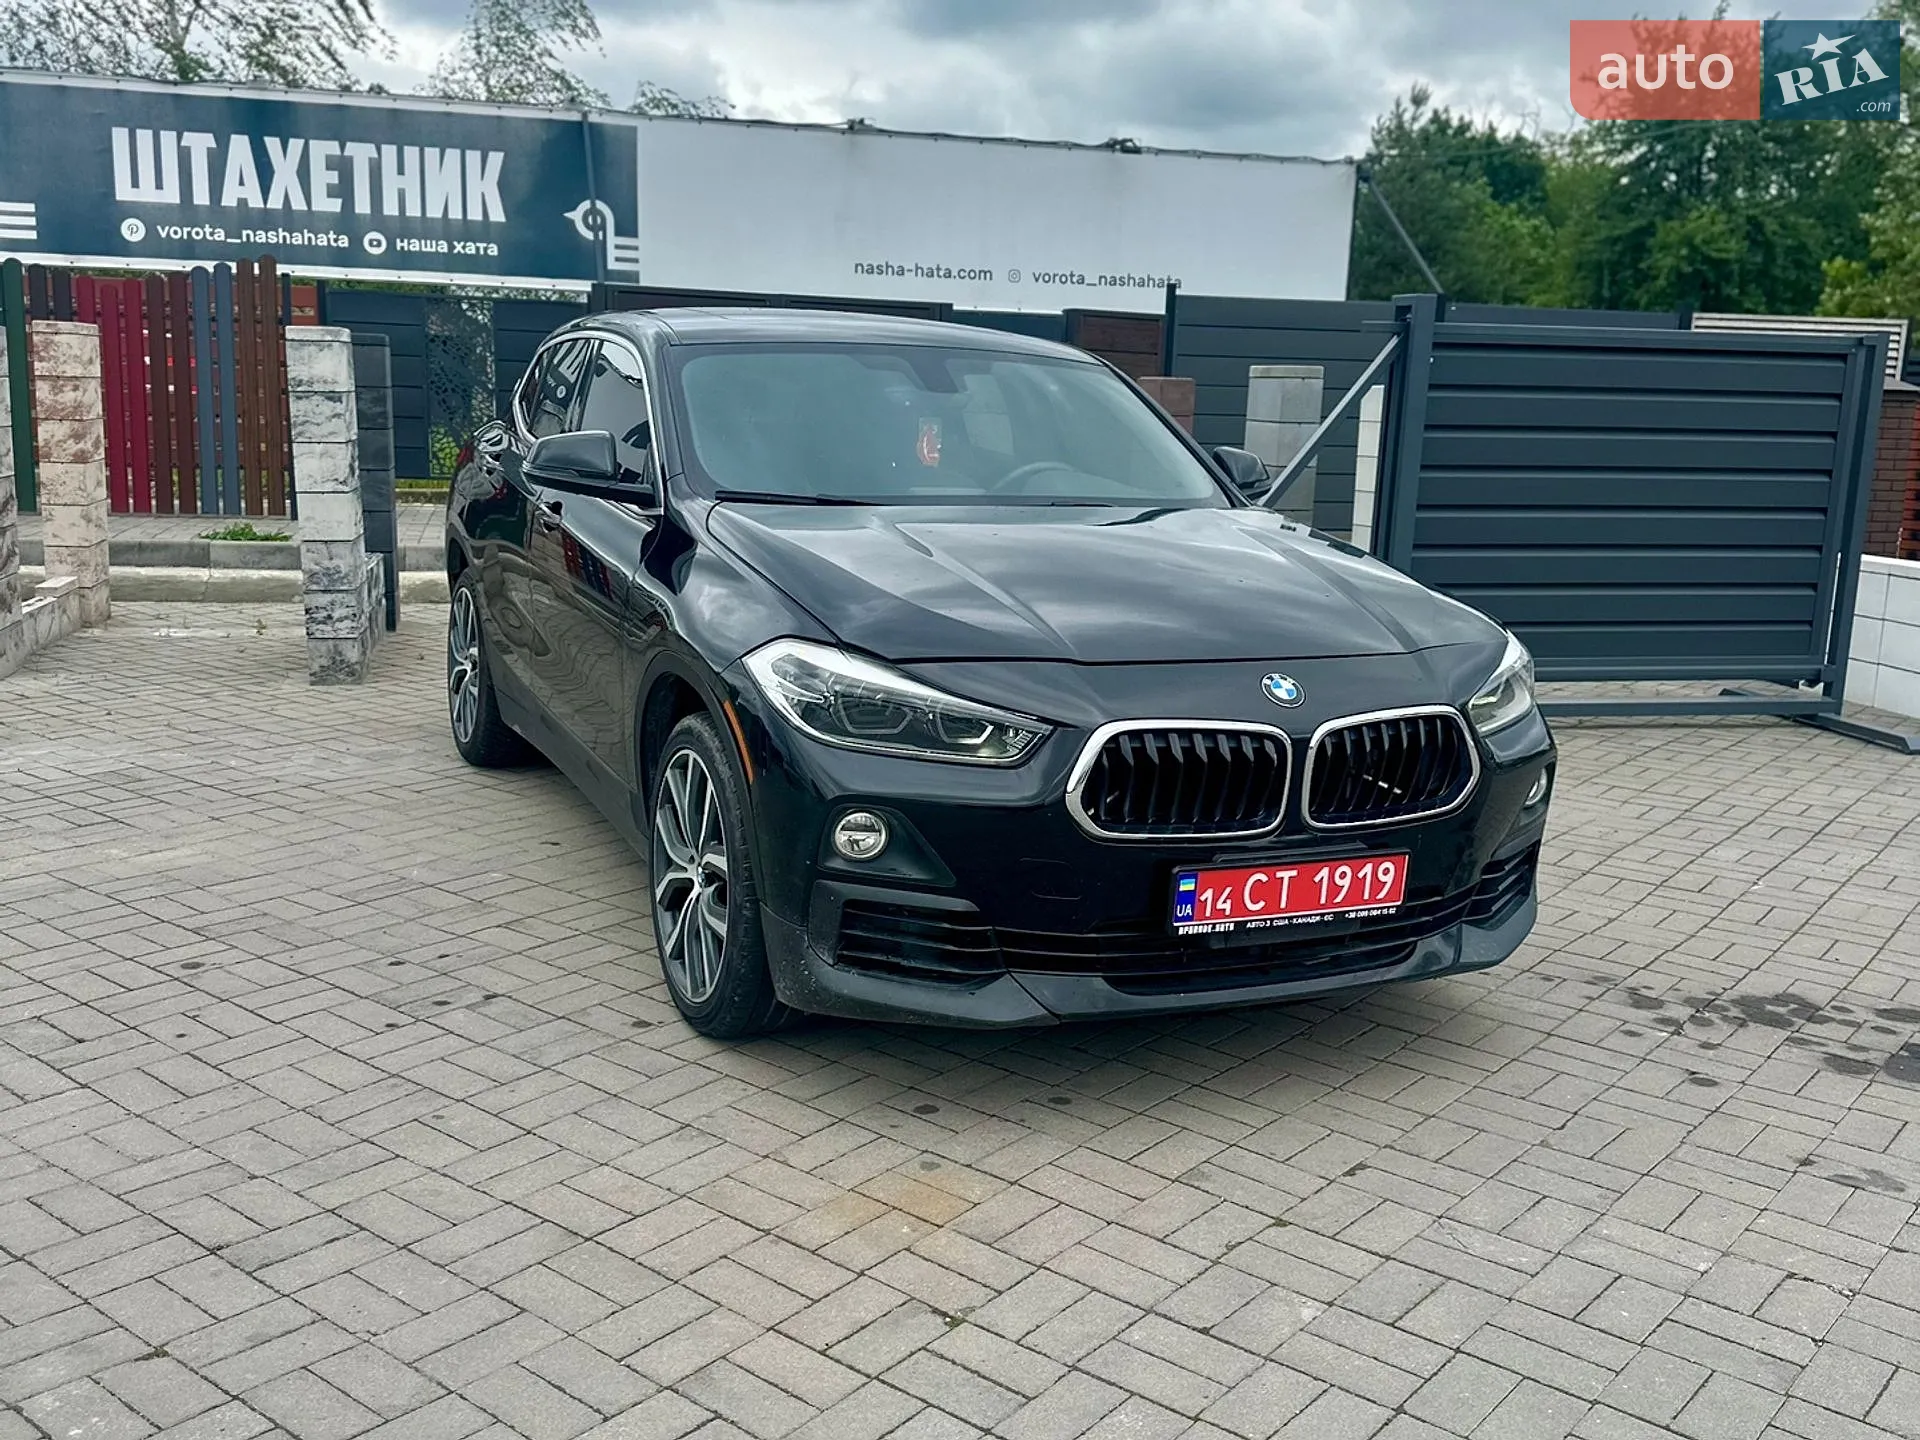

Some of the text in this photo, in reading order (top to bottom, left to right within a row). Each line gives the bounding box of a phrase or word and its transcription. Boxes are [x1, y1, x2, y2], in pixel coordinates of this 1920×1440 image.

[111, 126, 507, 222] ШТАХЕТНИК
[156, 223, 350, 248] vorota_nashahata
[395, 238, 499, 256] наша хата
[853, 260, 993, 282] nasha-hata.com
[1199, 860, 1397, 917] 14 CT 1919
[1176, 904, 1193, 917] UA
